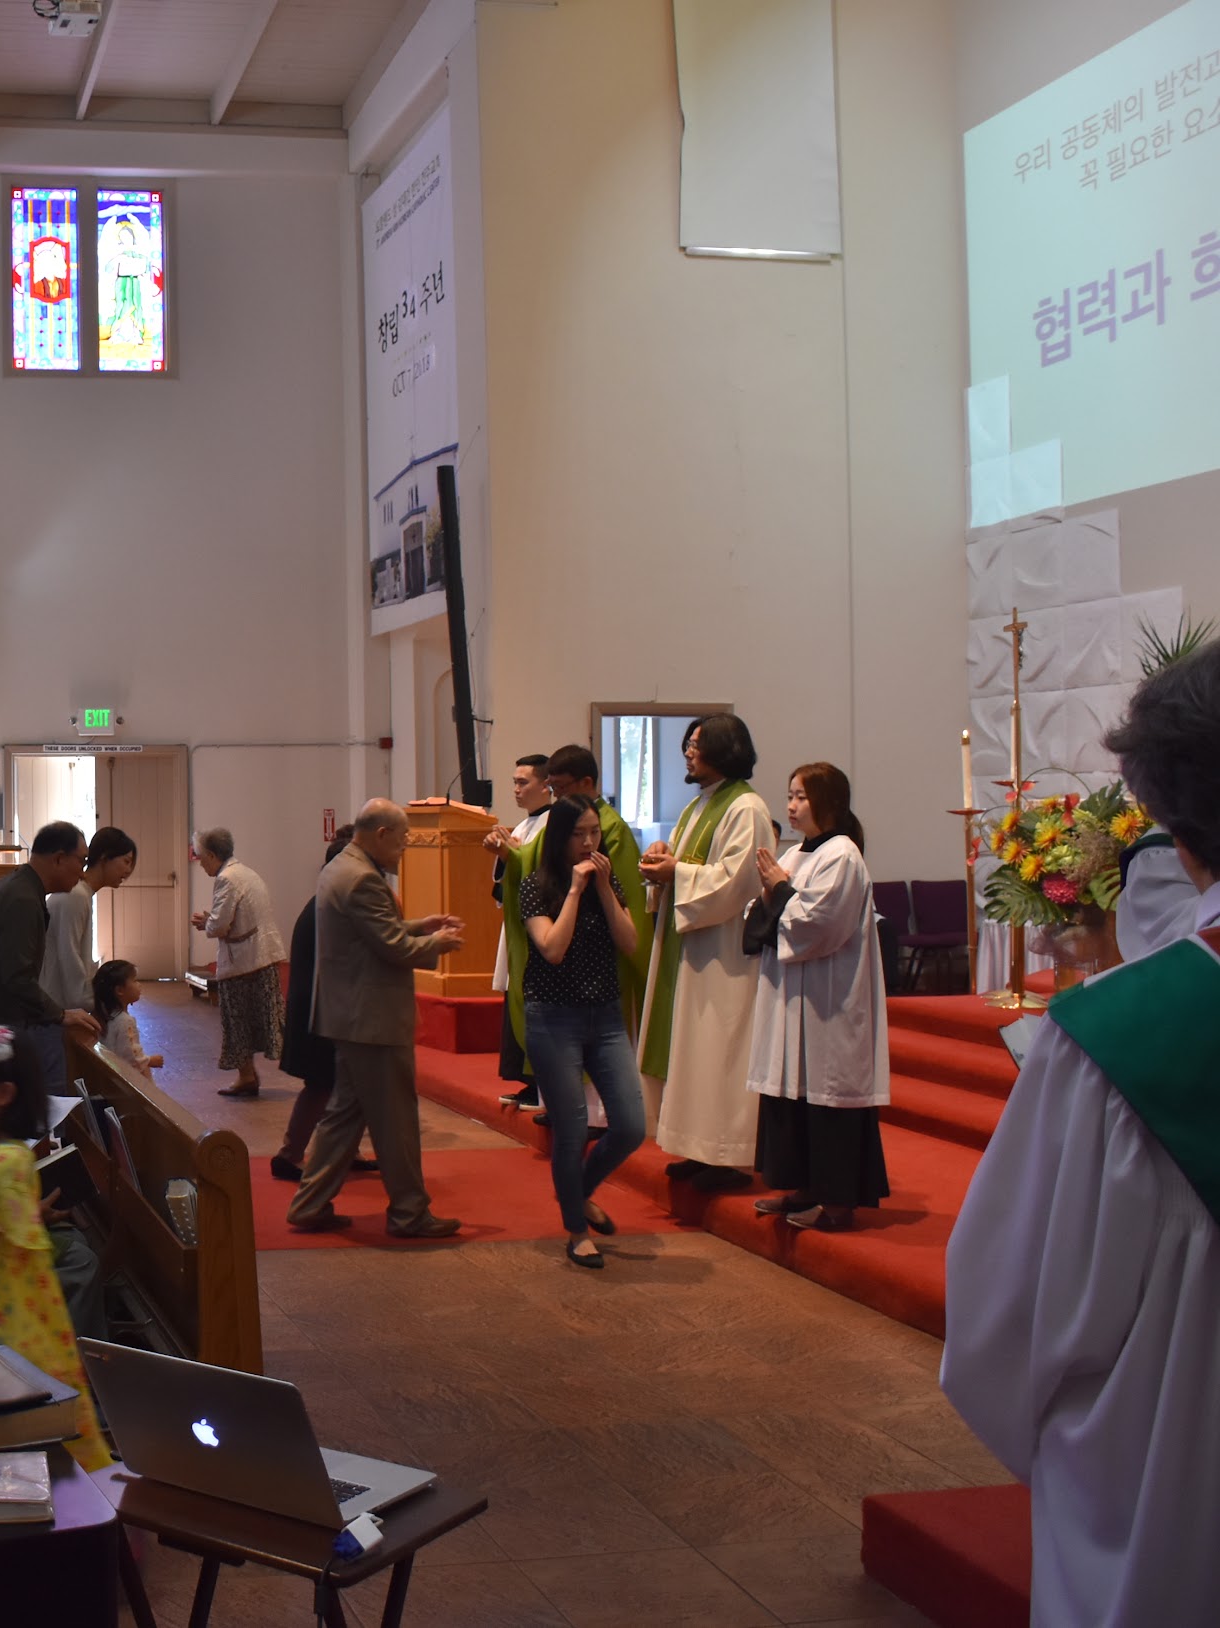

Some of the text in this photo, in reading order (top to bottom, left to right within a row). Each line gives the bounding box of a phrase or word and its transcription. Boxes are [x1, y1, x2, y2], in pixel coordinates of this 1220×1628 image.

[1013, 137, 1051, 184] 우리
[1060, 87, 1144, 161] 공동체의
[1079, 158, 1099, 191] 꼭
[1106, 119, 1175, 182] 필요한
[378, 303, 399, 353] 창립
[402, 290, 416, 319] 34
[420, 260, 445, 316] 주년
[1032, 248, 1172, 368] 협력과
[85, 709, 110, 727] EXIT
